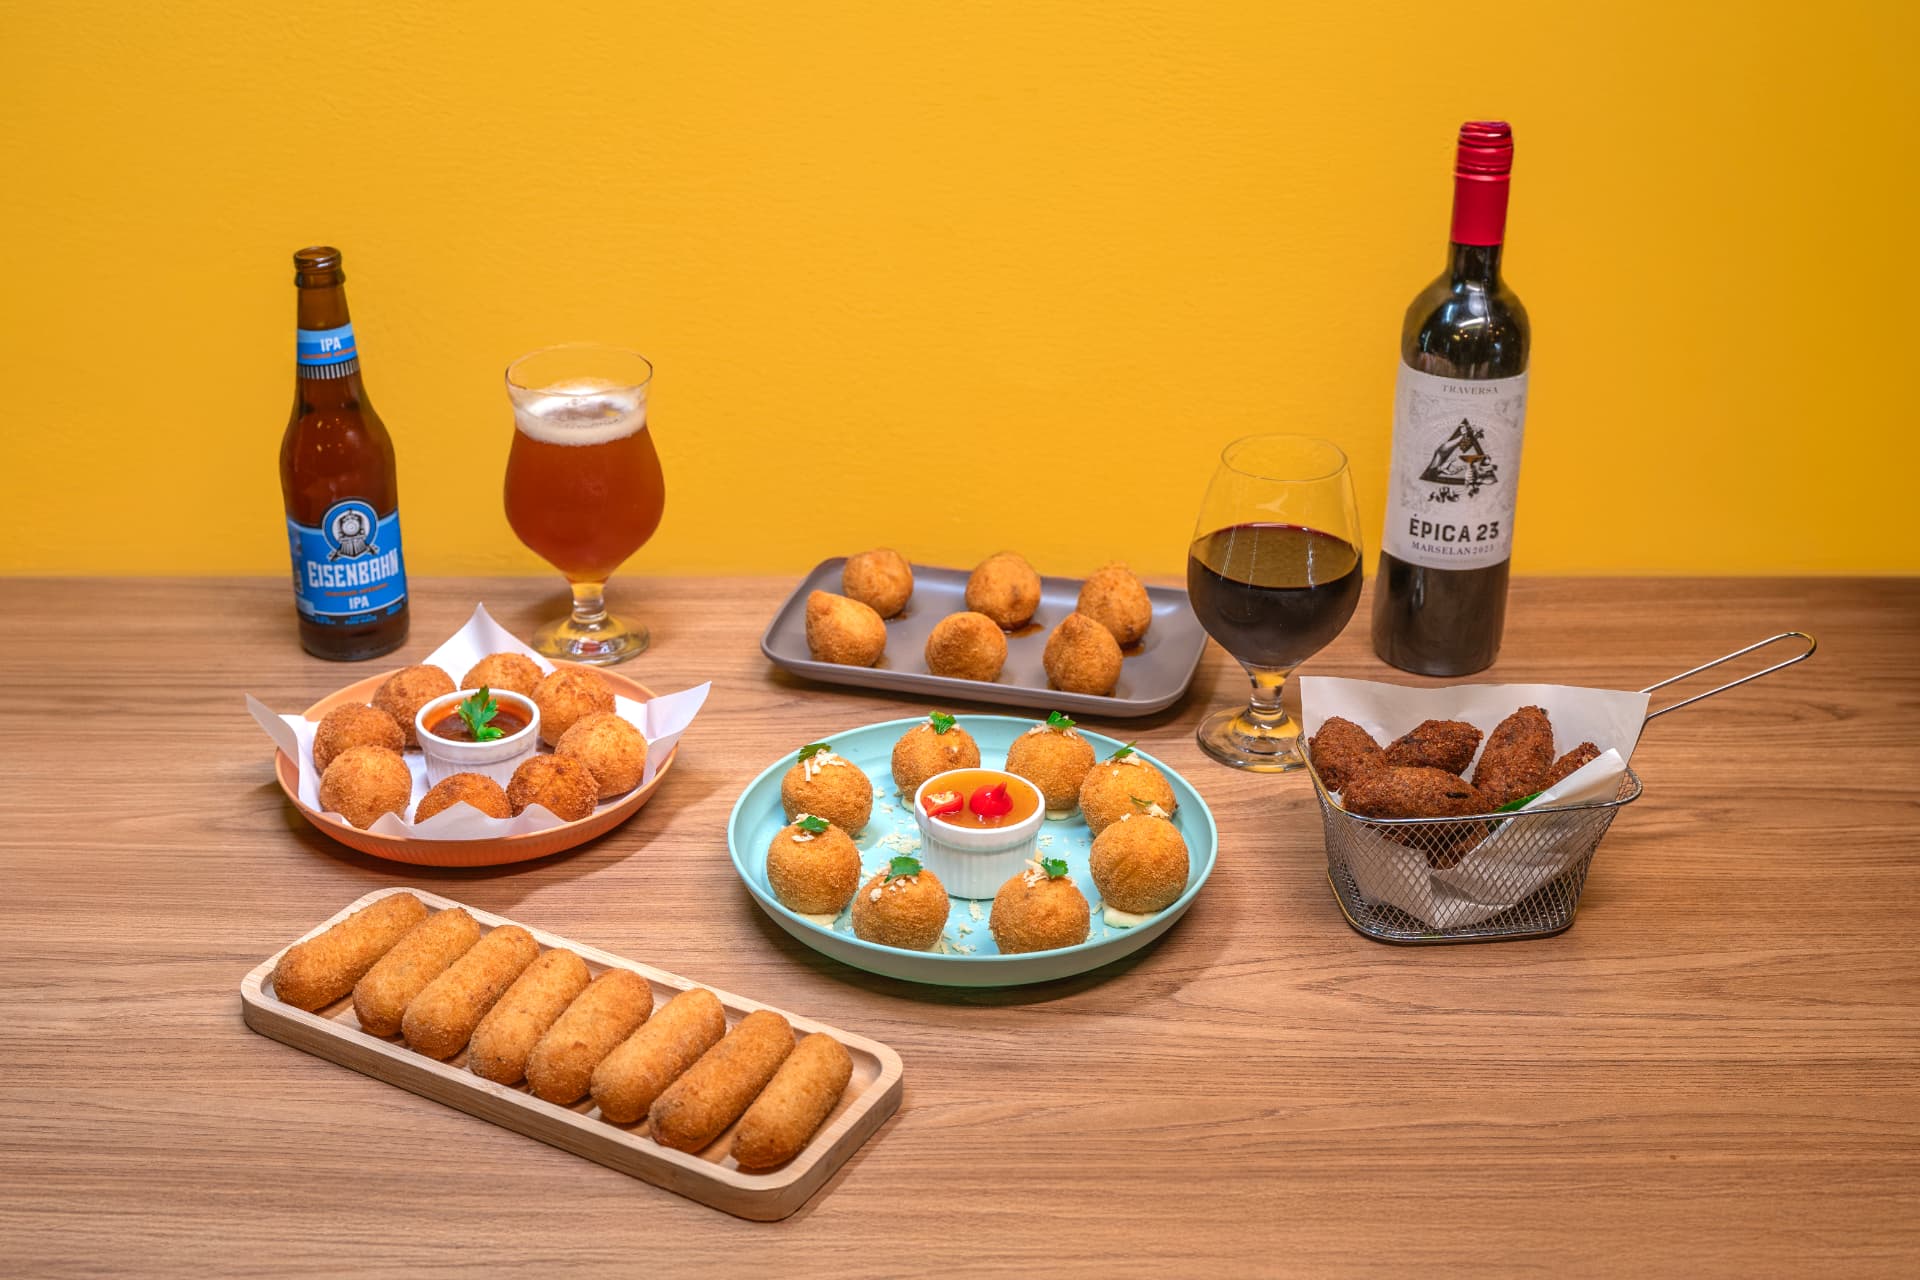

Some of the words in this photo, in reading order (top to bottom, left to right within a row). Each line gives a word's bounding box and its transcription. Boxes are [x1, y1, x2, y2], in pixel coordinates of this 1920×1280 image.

[320, 336, 341, 352] IPA
[1442, 384, 1499, 395] TRAVERSA
[1409, 513, 1471, 543] ÉPICA
[1476, 521, 1500, 542] 23
[1412, 541, 1471, 555] MARSELAN
[307, 546, 400, 588] EISENBAHN
[348, 594, 370, 610] IPA
